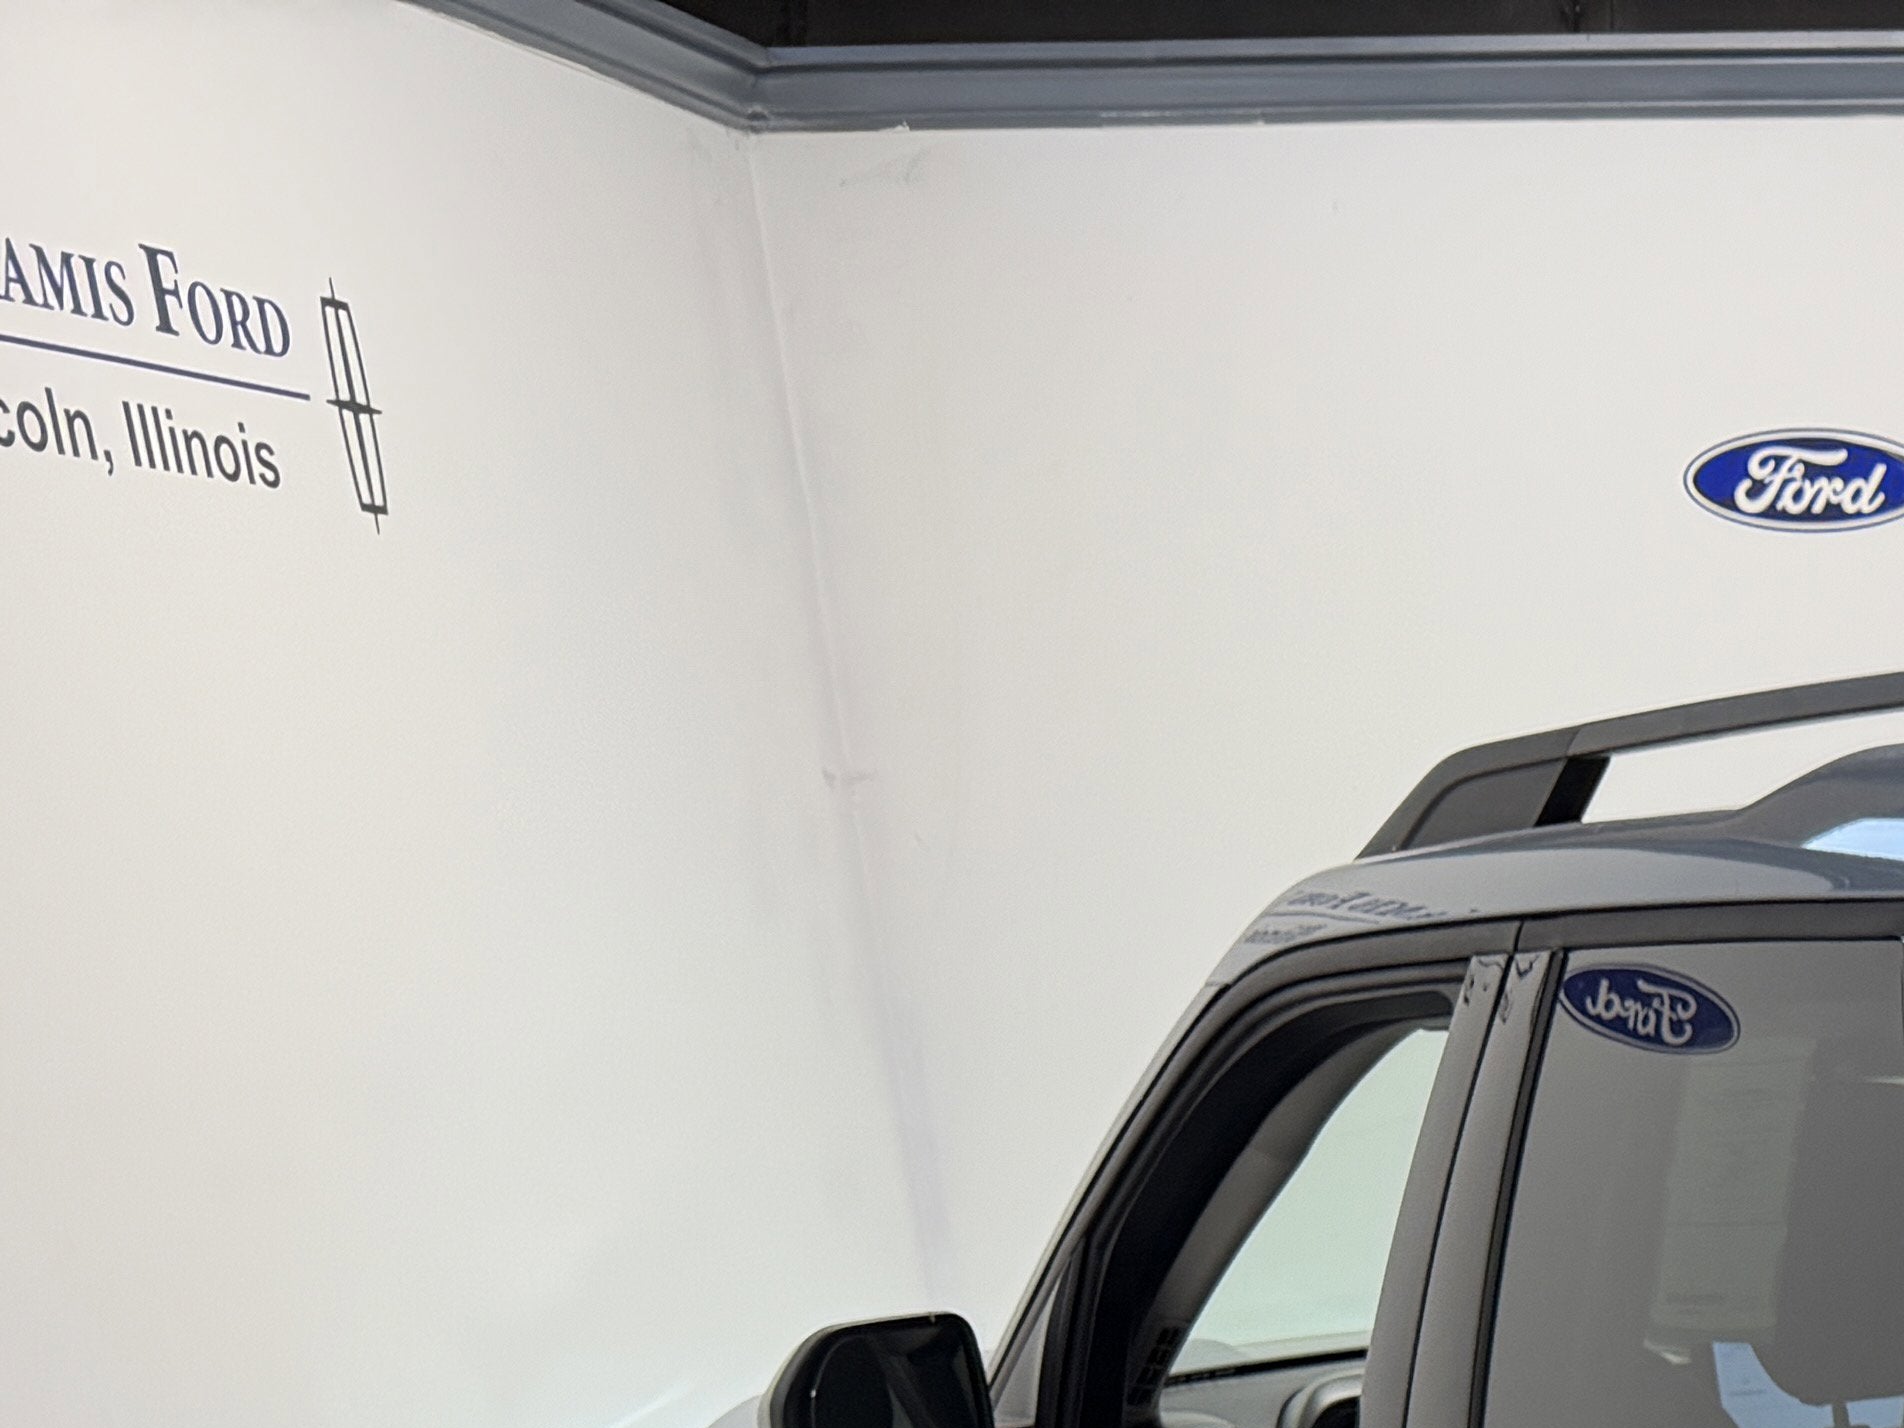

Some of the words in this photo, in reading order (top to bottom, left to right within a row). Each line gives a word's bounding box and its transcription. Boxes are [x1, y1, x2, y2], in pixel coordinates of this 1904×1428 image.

[0, 236, 135, 328] AMIS
[137, 243, 291, 358] FORD
[121, 399, 282, 490] Illinois
[1734, 446, 1887, 514] Ford
